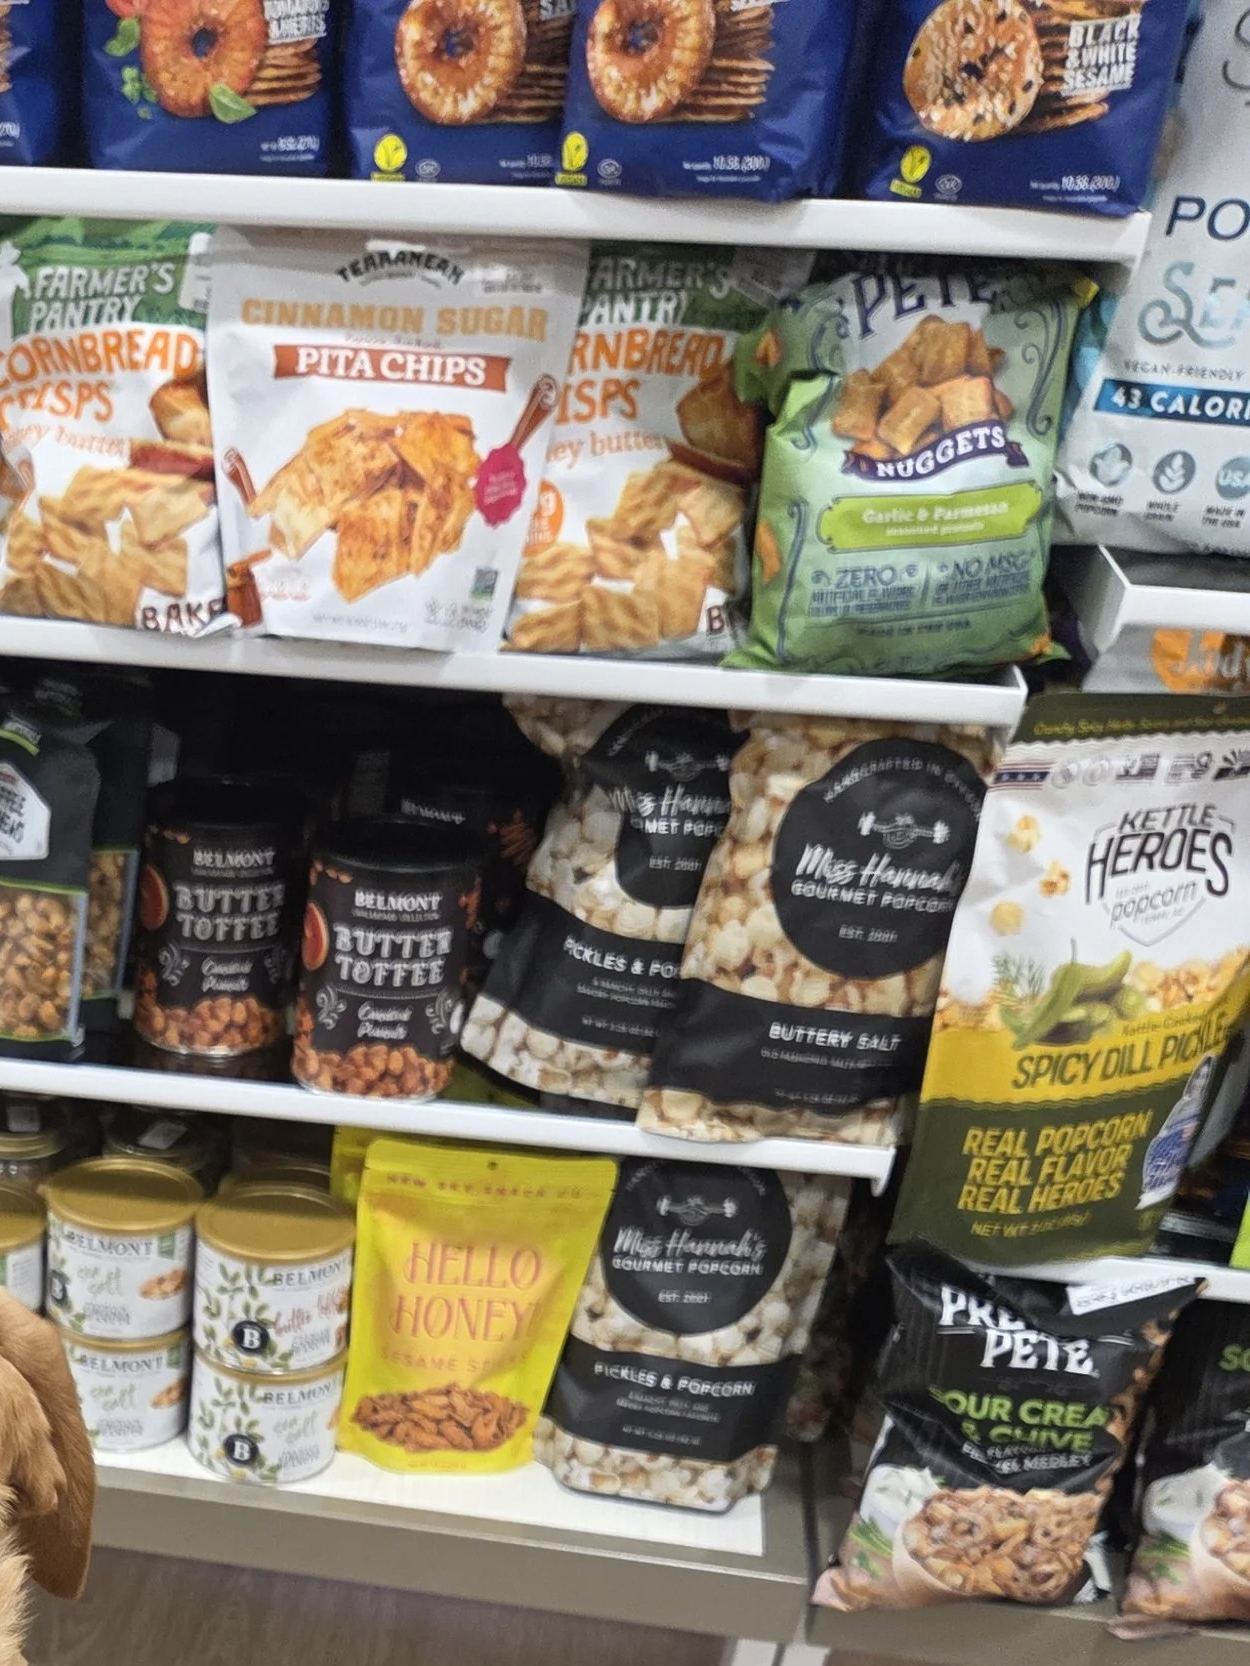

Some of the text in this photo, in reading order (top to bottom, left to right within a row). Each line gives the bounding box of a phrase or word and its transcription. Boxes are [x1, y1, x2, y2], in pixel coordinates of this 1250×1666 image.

[36, 262, 175, 299] FARMER'S
[592, 257, 734, 299] ARMER'S
[29, 295, 142, 334] PANTRY
[241, 297, 425, 334] CINNAMON
[436, 304, 548, 343] SUGAR
[297, 346, 488, 387] PITA CHIPS
[567, 328, 724, 381] RNBREAD
[554, 377, 641, 426] ISPS
[1111, 384, 1143, 410] 43
[875, 425, 1007, 479] NUGGETS
[862, 507, 913, 525] Garlic
[933, 501, 1010, 522] Parmesan
[835, 565, 899, 589] ZERO
[1117, 802, 1219, 833] KETTLE
[192, 848, 277, 868] BELMONT
[1084, 827, 1235, 906] HEROES
[173, 881, 286, 914] BUTTER
[354, 889, 443, 912] BELMONT
[790, 879, 879, 907] GOURMET
[1109, 880, 1199, 930] popcorn
[175, 911, 280, 942] TOFFEE
[333, 922, 454, 958] BUTTER
[335, 954, 448, 988] TOFFEE
[768, 1021, 902, 1052] BUTTERY SALT
[1011, 1052, 1101, 1091] SPICY
[1101, 1041, 1153, 1081] DILL
[961, 1108, 1155, 1159] REAL POPCORN
[966, 1144, 1134, 1187] REAL FLAVOR
[956, 1172, 1126, 1216] REAL HEROES
[62, 1230, 154, 1257] BELMONT
[403, 1240, 545, 1291] HELLO
[612, 1256, 764, 1277] GOURMET POPCORN
[387, 1294, 538, 1343] HONEY
[980, 1328, 1099, 1377] PETE
[593, 1363, 756, 1398] PICKLES & POPCORN
[1018, 1398, 1111, 1428] CREA
